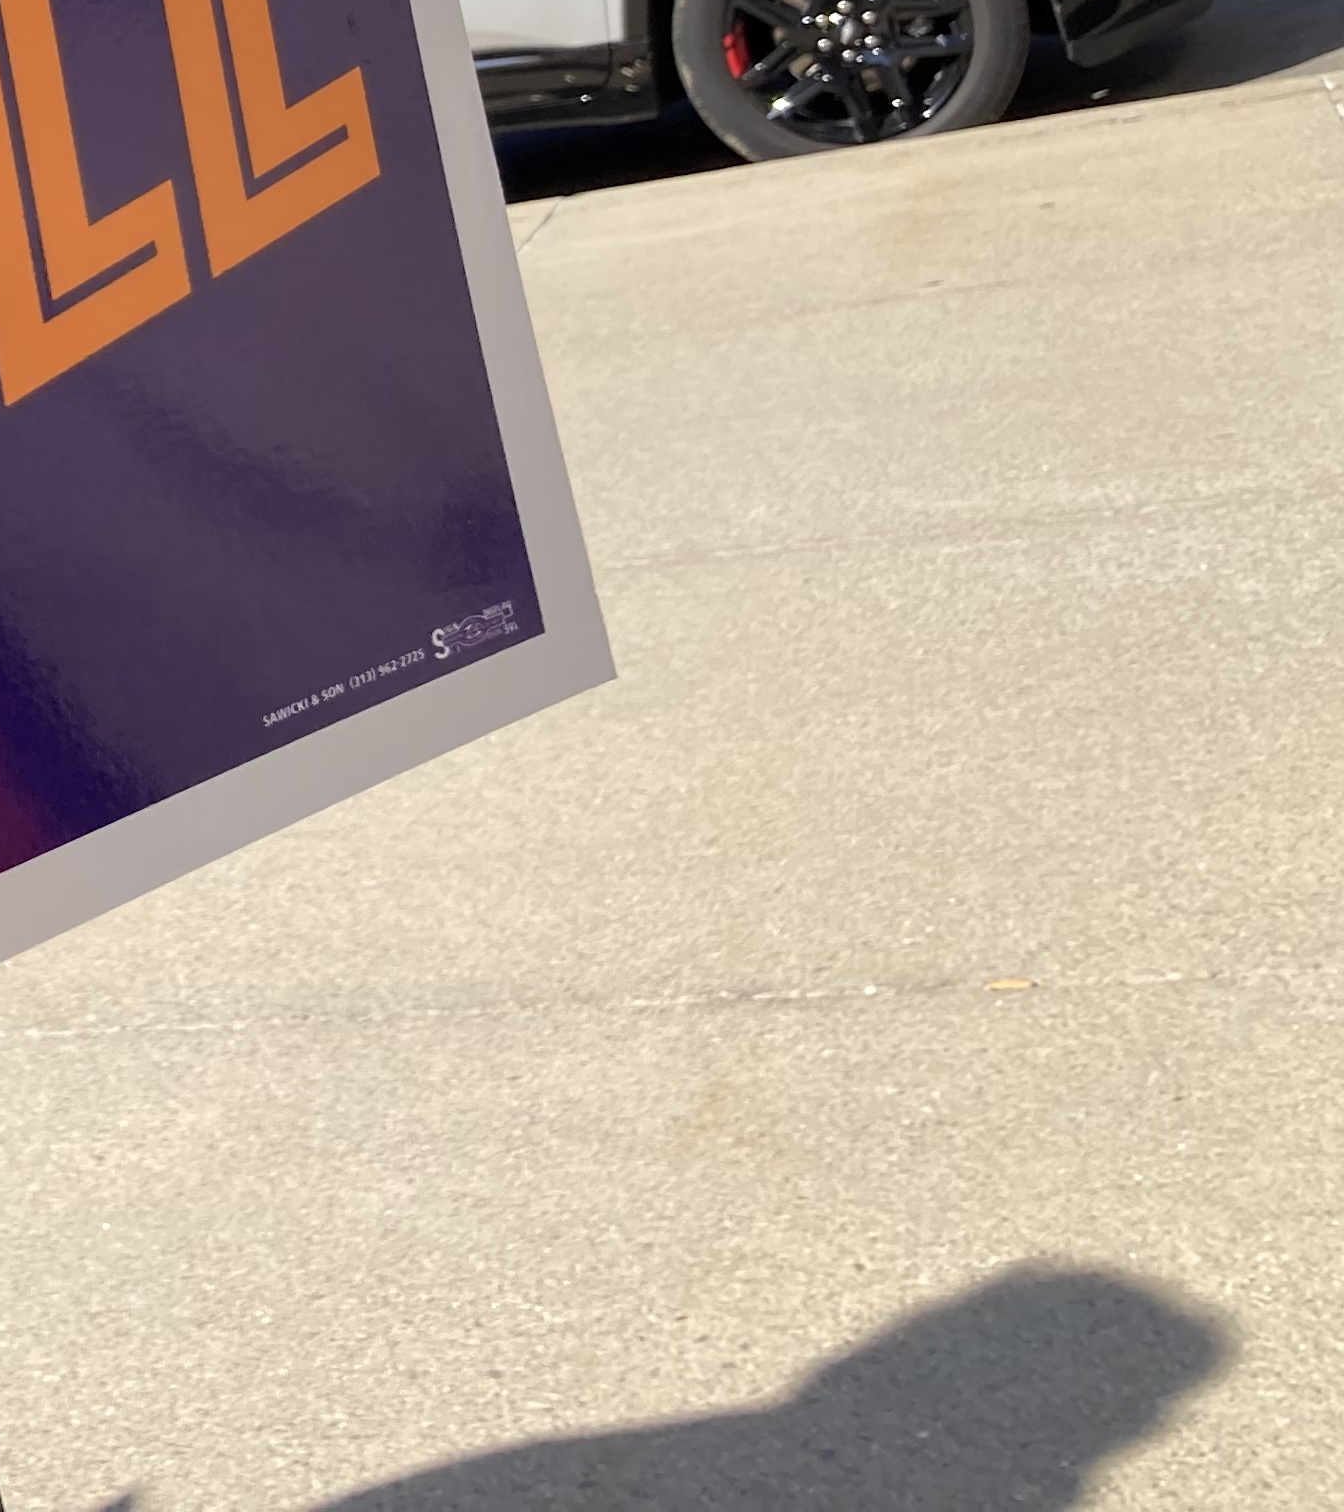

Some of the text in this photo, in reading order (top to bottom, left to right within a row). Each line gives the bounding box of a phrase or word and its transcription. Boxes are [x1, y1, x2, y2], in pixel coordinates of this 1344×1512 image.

[262, 697, 310, 727] SAWICKI
[310, 693, 320, 706] &
[320, 682, 345, 701] SON
